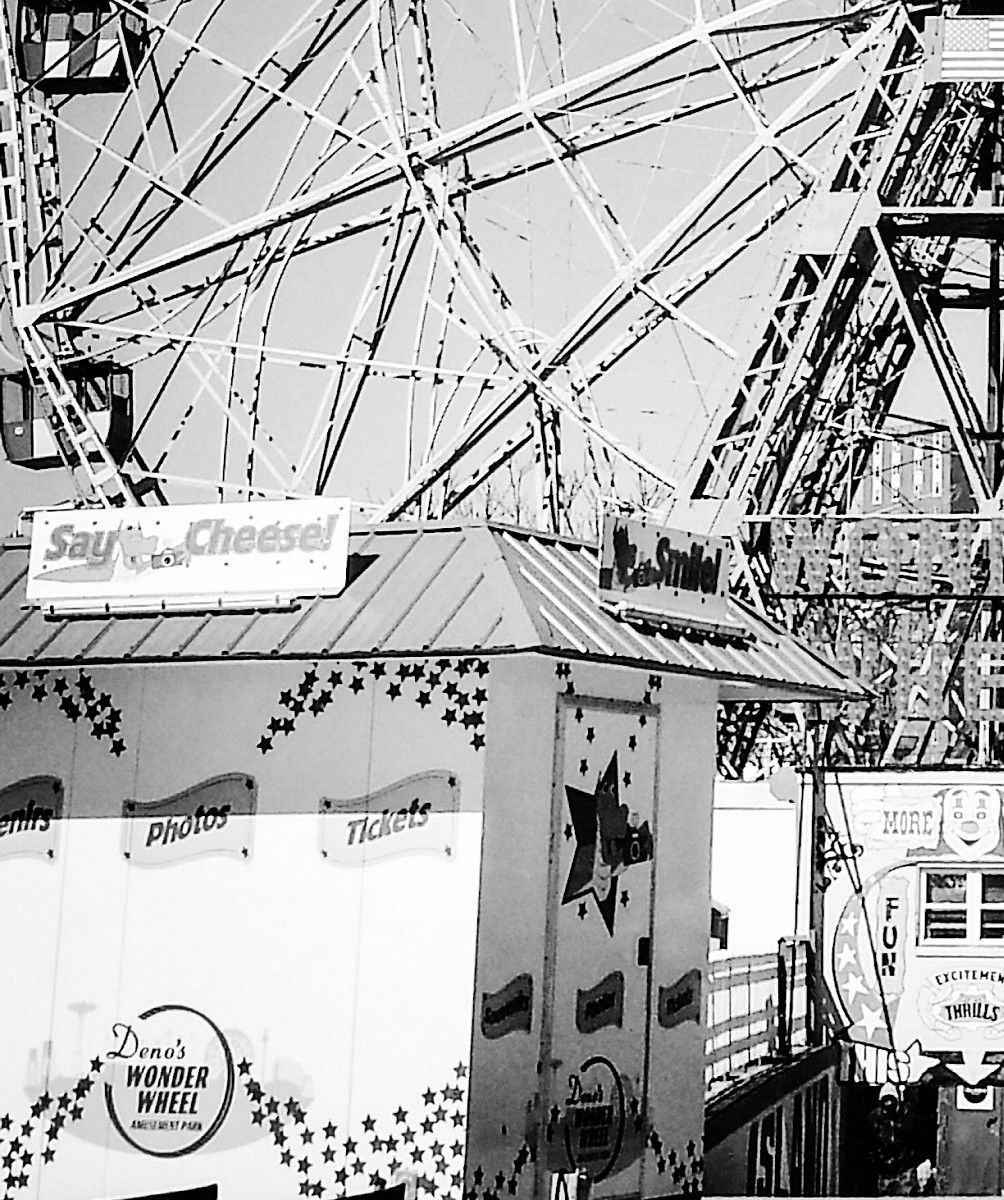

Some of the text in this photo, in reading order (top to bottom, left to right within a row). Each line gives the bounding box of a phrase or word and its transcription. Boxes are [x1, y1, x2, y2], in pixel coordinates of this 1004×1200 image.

[44, 514, 339, 566] Say Cheese!
[145, 804, 231, 847] Photos
[347, 797, 432, 846] Tickets
[883, 810, 933, 835] MORE
[881, 897, 899, 977] FUN
[945, 1003, 1000, 1022] THRILLS
[106, 1022, 186, 1060] Deno's
[127, 1065, 209, 1089] WONDER
[137, 1090, 198, 1114] WHEEL
